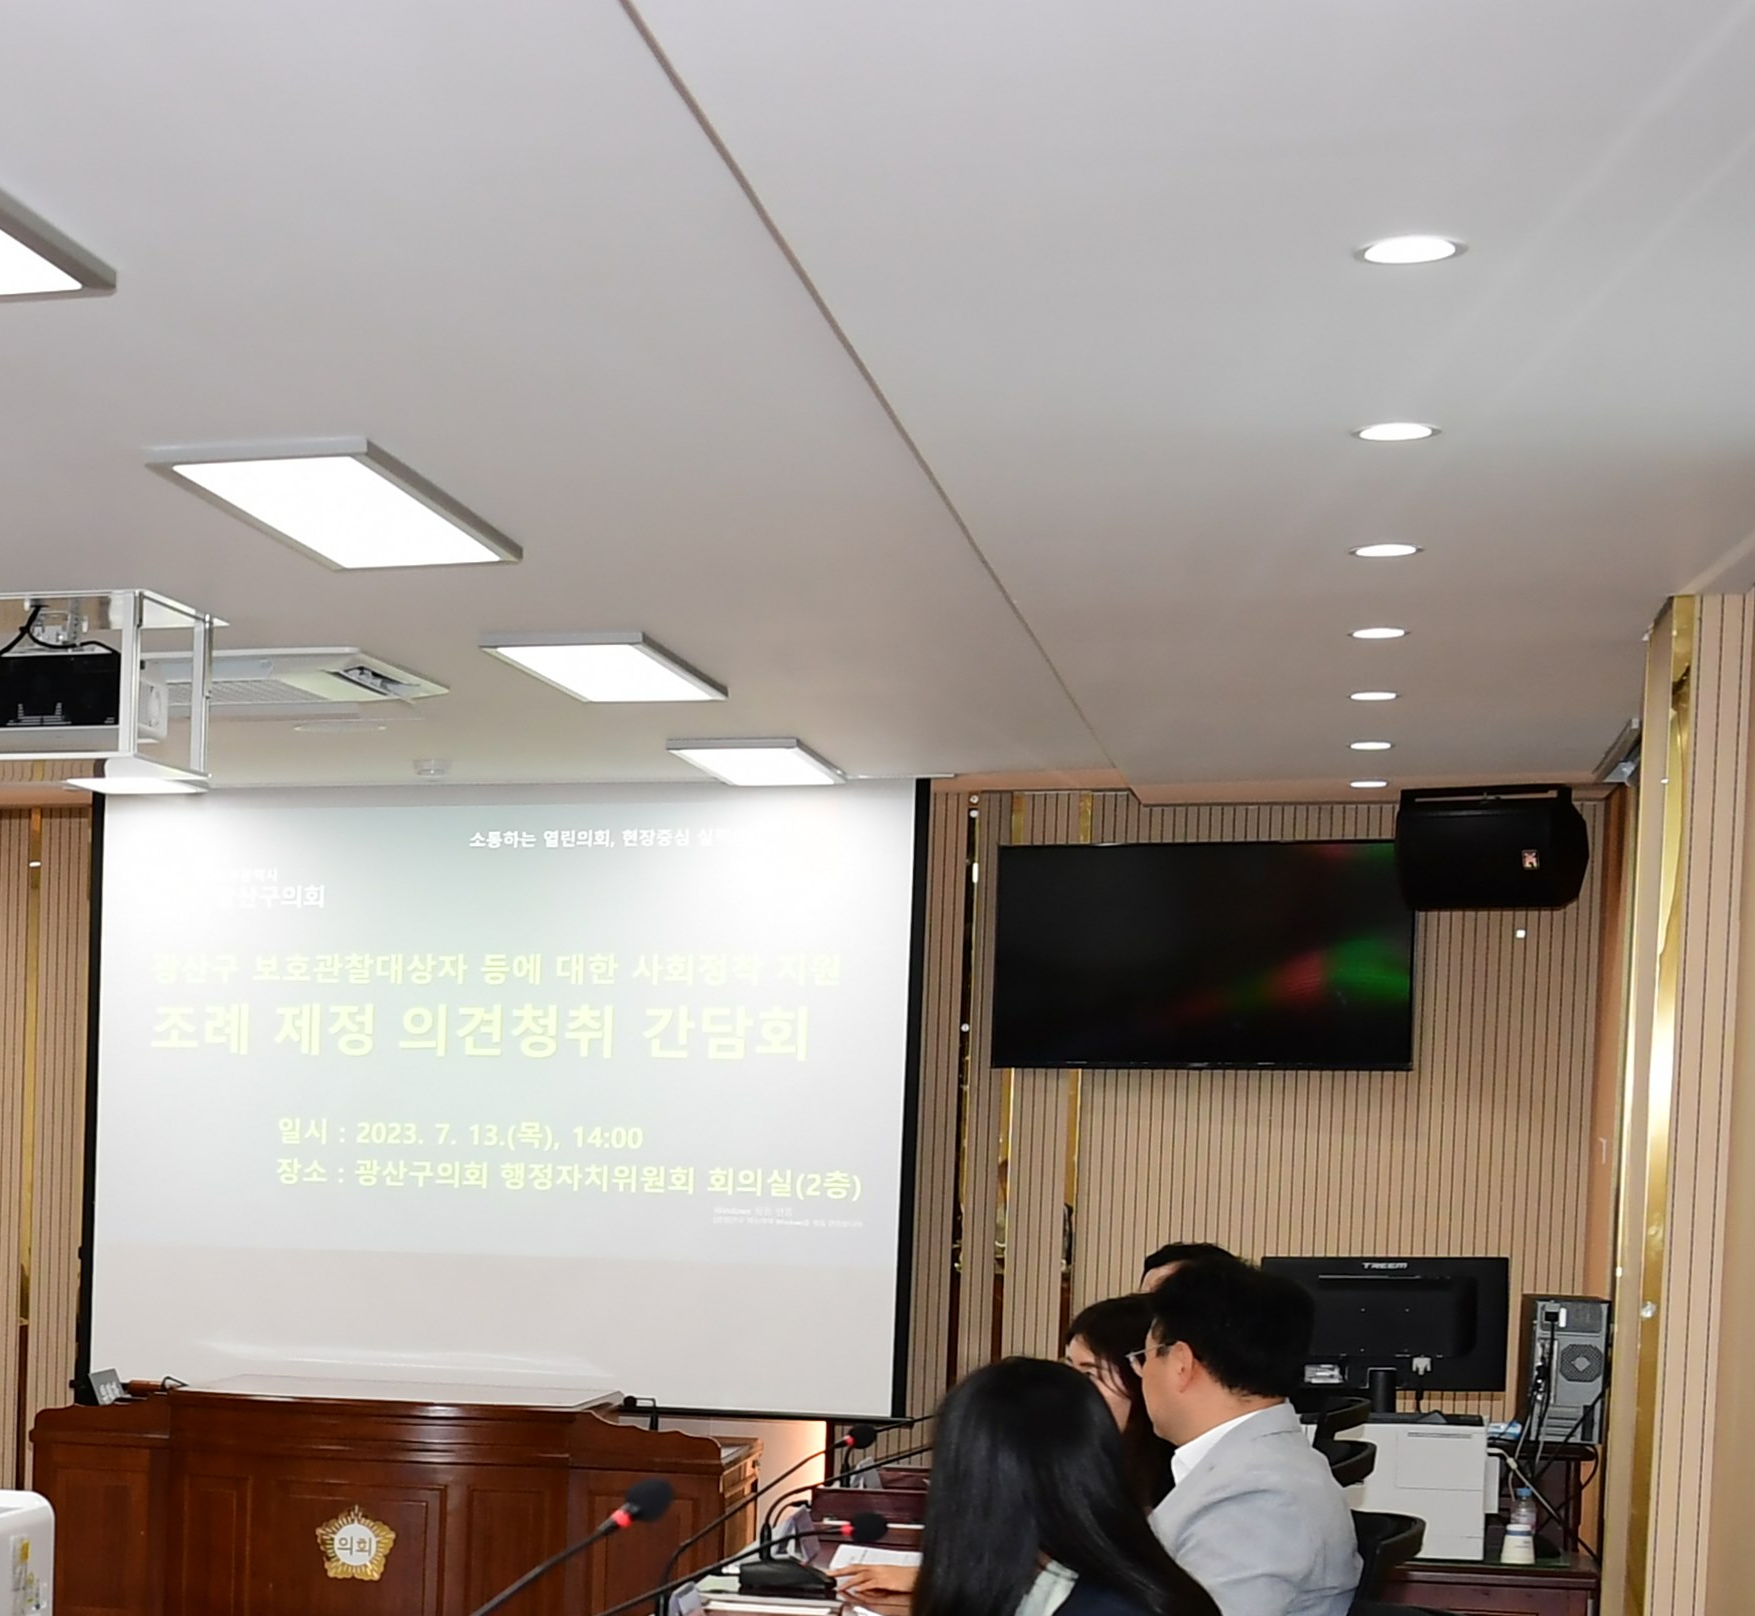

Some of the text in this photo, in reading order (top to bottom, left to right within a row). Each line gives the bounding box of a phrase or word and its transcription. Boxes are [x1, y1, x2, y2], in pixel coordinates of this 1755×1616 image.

[469, 830, 537, 848] 소통하는
[543, 829, 615, 848] 열린의회,
[622, 829, 690, 847] 현장중심
[153, 953, 842, 986] 광산구 보호관찰대상자 등에 대한 사회정착 지원
[149, 1004, 810, 1061] 조례 제정 의견청취 간담회
[277, 1117, 329, 1146] 일시
[355, 1121, 424, 1145] 2023.
[435, 1123, 457, 1146] 7.
[572, 1125, 643, 1150] 14:00
[276, 1158, 328, 1187] 장소
[354, 1160, 489, 1190] 광산구의회
[499, 1162, 695, 1195] 행정자치위원회
[706, 1167, 863, 1202] 회의실(2층)
[337, 1536, 372, 1556] 의회
